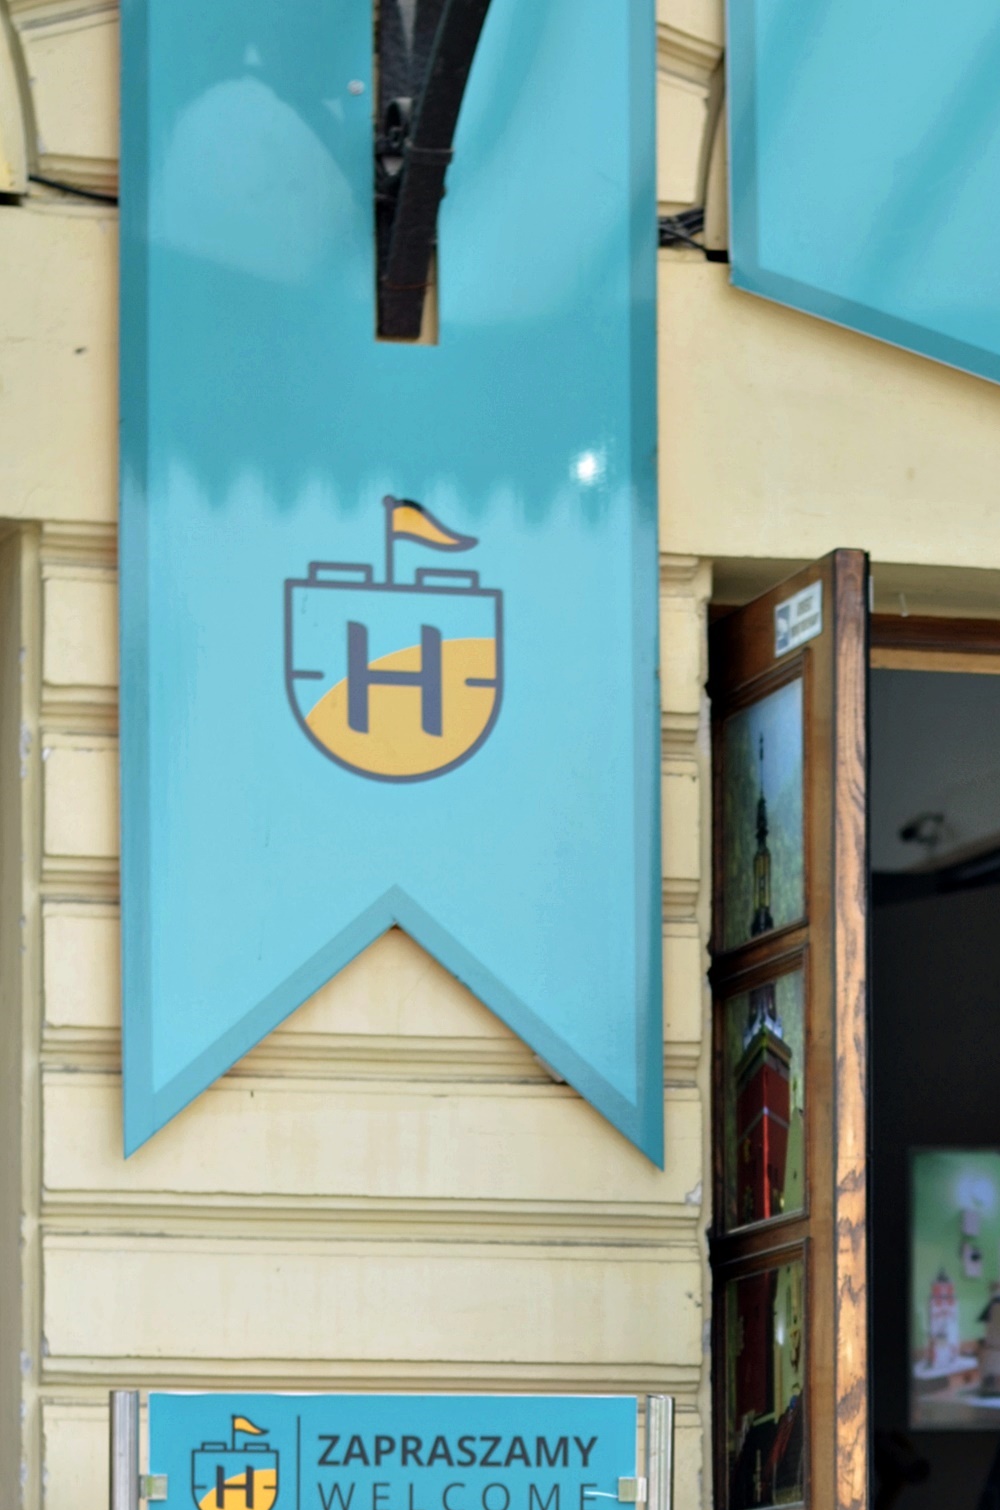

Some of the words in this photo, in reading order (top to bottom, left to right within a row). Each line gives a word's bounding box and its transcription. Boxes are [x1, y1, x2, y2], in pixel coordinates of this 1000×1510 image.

[346, 620, 443, 738] H
[317, 1434, 599, 1468] ZAPRASZAMY
[216, 1465, 255, 1510] H
